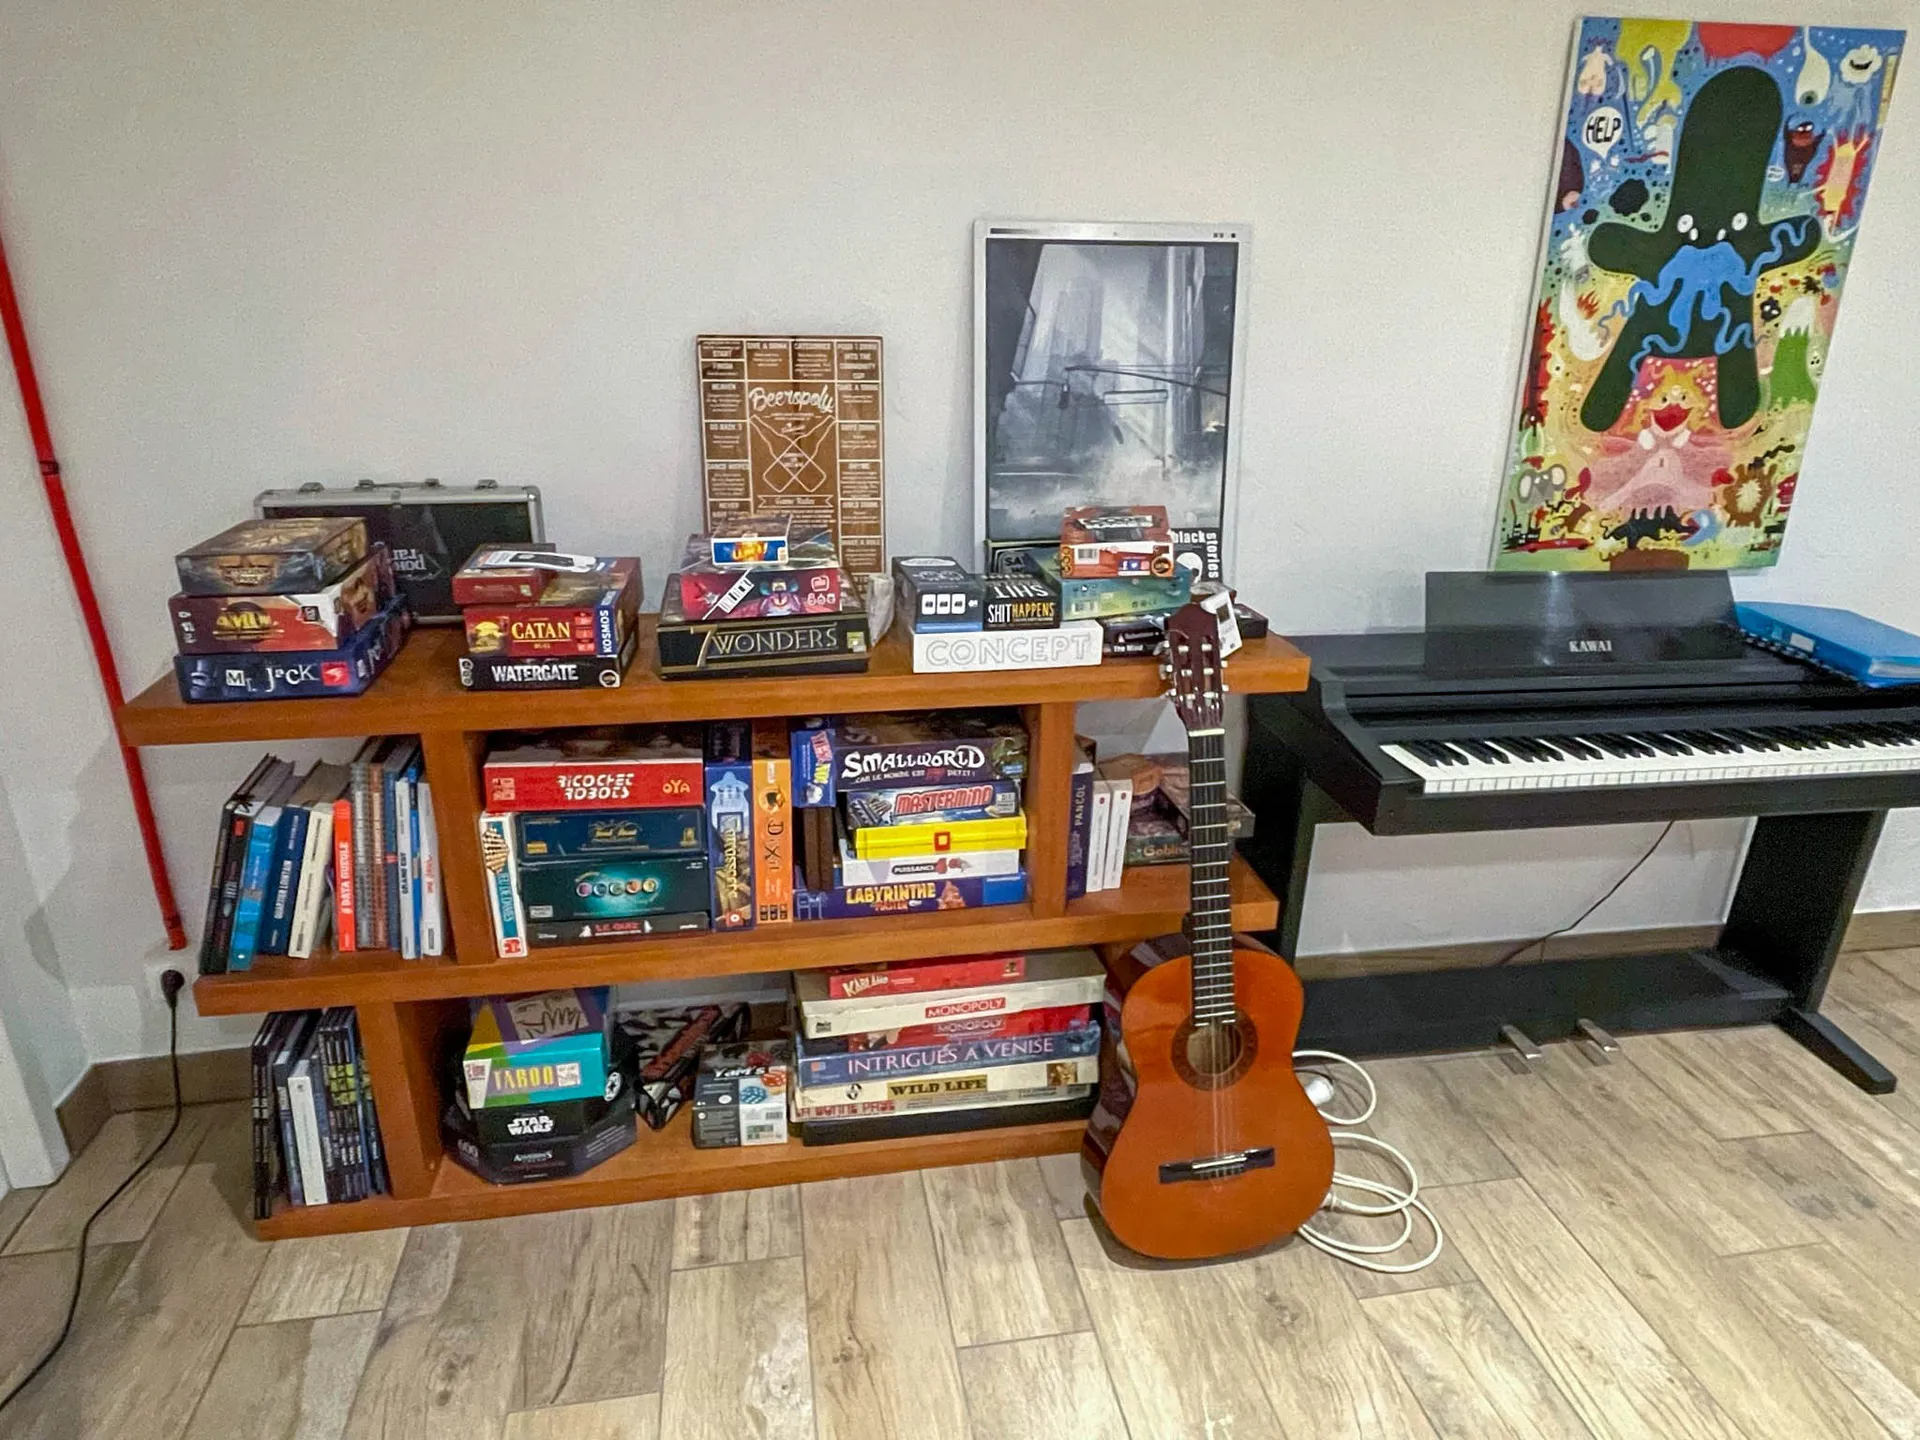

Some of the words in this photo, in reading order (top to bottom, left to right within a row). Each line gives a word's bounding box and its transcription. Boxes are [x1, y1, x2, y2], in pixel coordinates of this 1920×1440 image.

[1585, 115, 1623, 144] HELP
[748, 383, 835, 413] Beeropoly
[1206, 532, 1220, 579] stories
[988, 602, 1012, 624] SHIT
[1011, 601, 1056, 622] HAPPENS
[511, 622, 571, 640] CATAN
[599, 609, 613, 654] KOSMOS
[711, 627, 838, 655] WONDERS
[926, 630, 1093, 667] CONCEPT
[1568, 639, 1613, 654] KAWAI
[491, 663, 580, 683] WATERGATE
[556, 772, 635, 789] RICOCHET
[564, 786, 630, 800] ROBOTS
[894, 864, 936, 874] PUISSANC
[846, 882, 936, 905] LABYRINTHE
[927, 997, 1004, 1018] MONOPOLY
[937, 1018, 1003, 1034] MONOPOLY
[848, 1047, 958, 1075] INTRIGUES
[980, 1037, 1054, 1058] VENISE
[493, 1065, 555, 1091] TABOO
[890, 1082, 940, 1097] WILD
[944, 1077, 987, 1092] LIFE
[507, 1115, 550, 1127] STAR
[508, 1121, 554, 1136] WARS
